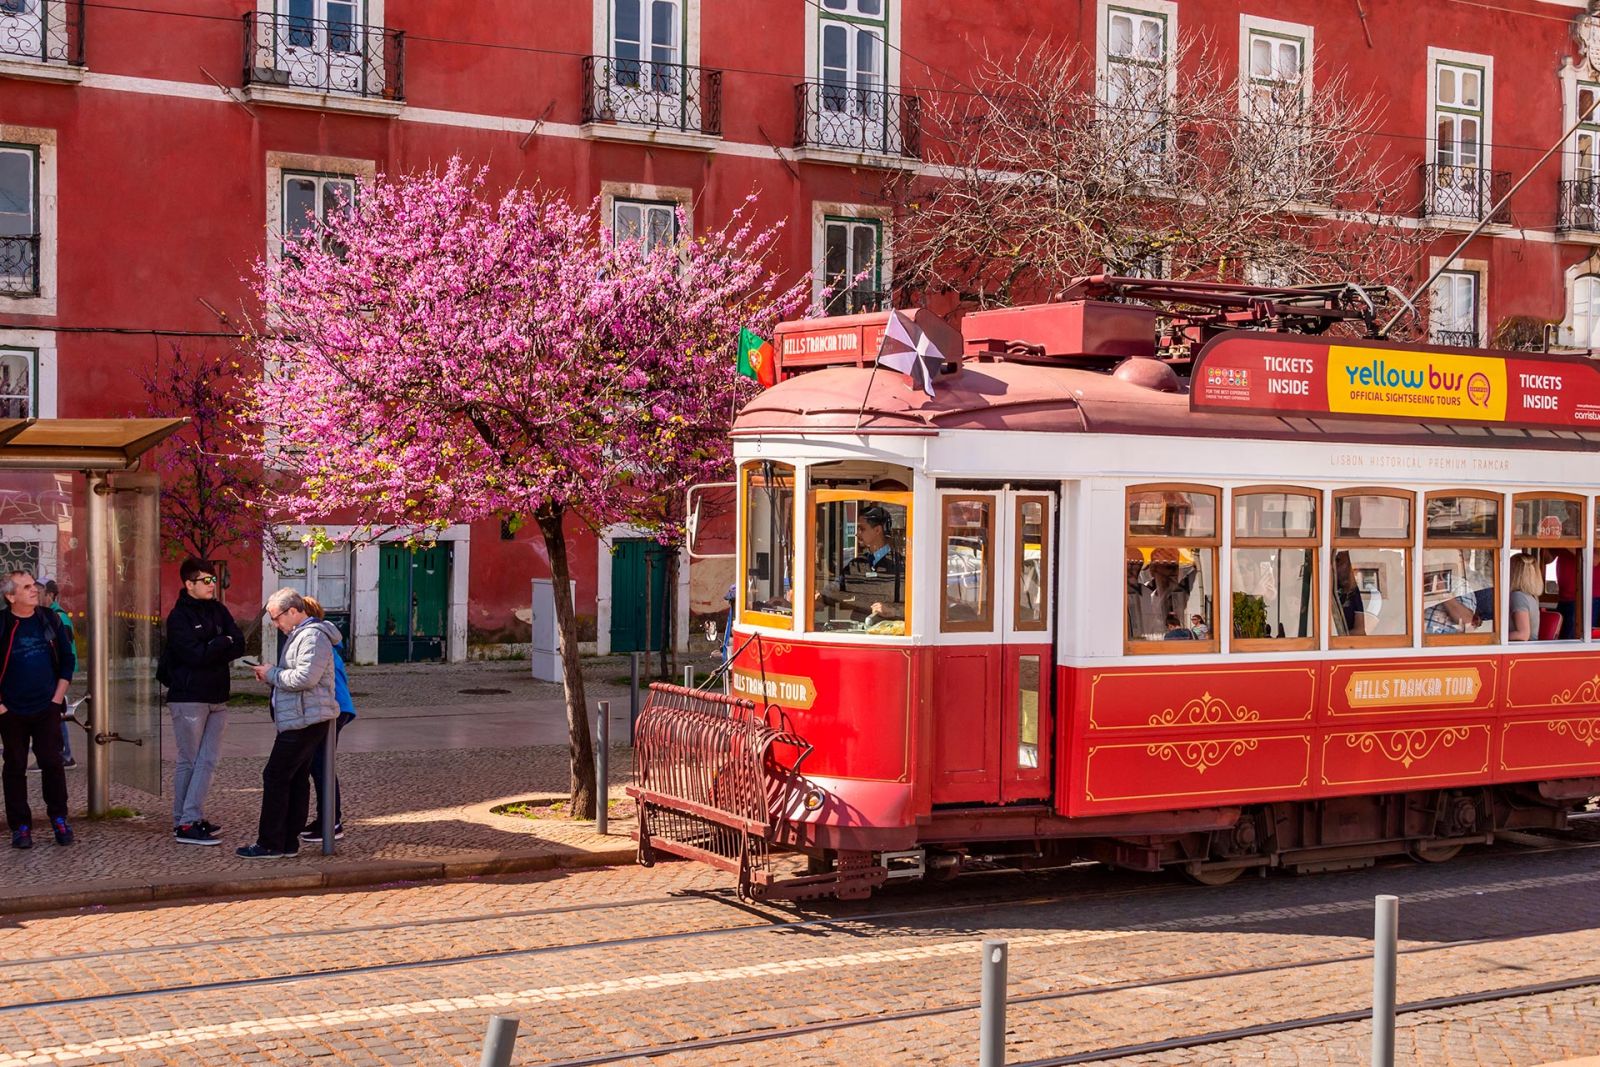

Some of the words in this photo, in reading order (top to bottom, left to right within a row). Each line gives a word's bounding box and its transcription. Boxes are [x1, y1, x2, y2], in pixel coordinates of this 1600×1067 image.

[784, 337, 806, 354] HILLS
[806, 334, 837, 353] TRAMCAR
[837, 333, 857, 350] TOUR
[1263, 356, 1314, 374] TICKETS
[1429, 364, 1463, 391] bus
[1519, 373, 1562, 391] TICKETS
[1268, 378, 1309, 396] INSIDE
[1350, 391, 1384, 402] OFFICIAL
[1386, 392, 1435, 405] SIGHTSEEING
[1437, 396, 1461, 406] TOURS
[1523, 394, 1559, 410] INSIDE
[1330, 455, 1363, 466] LISBON
[1369, 456, 1422, 469] HISTORICAL
[1428, 458, 1467, 470] PREMIUM
[1472, 459, 1511, 471] TRAMCAR
[779, 681, 806, 701] TOUR
[1354, 679, 1389, 699] HILLS
[1393, 678, 1442, 698] TRAMCAR
[1445, 676, 1473, 696] TOUR
